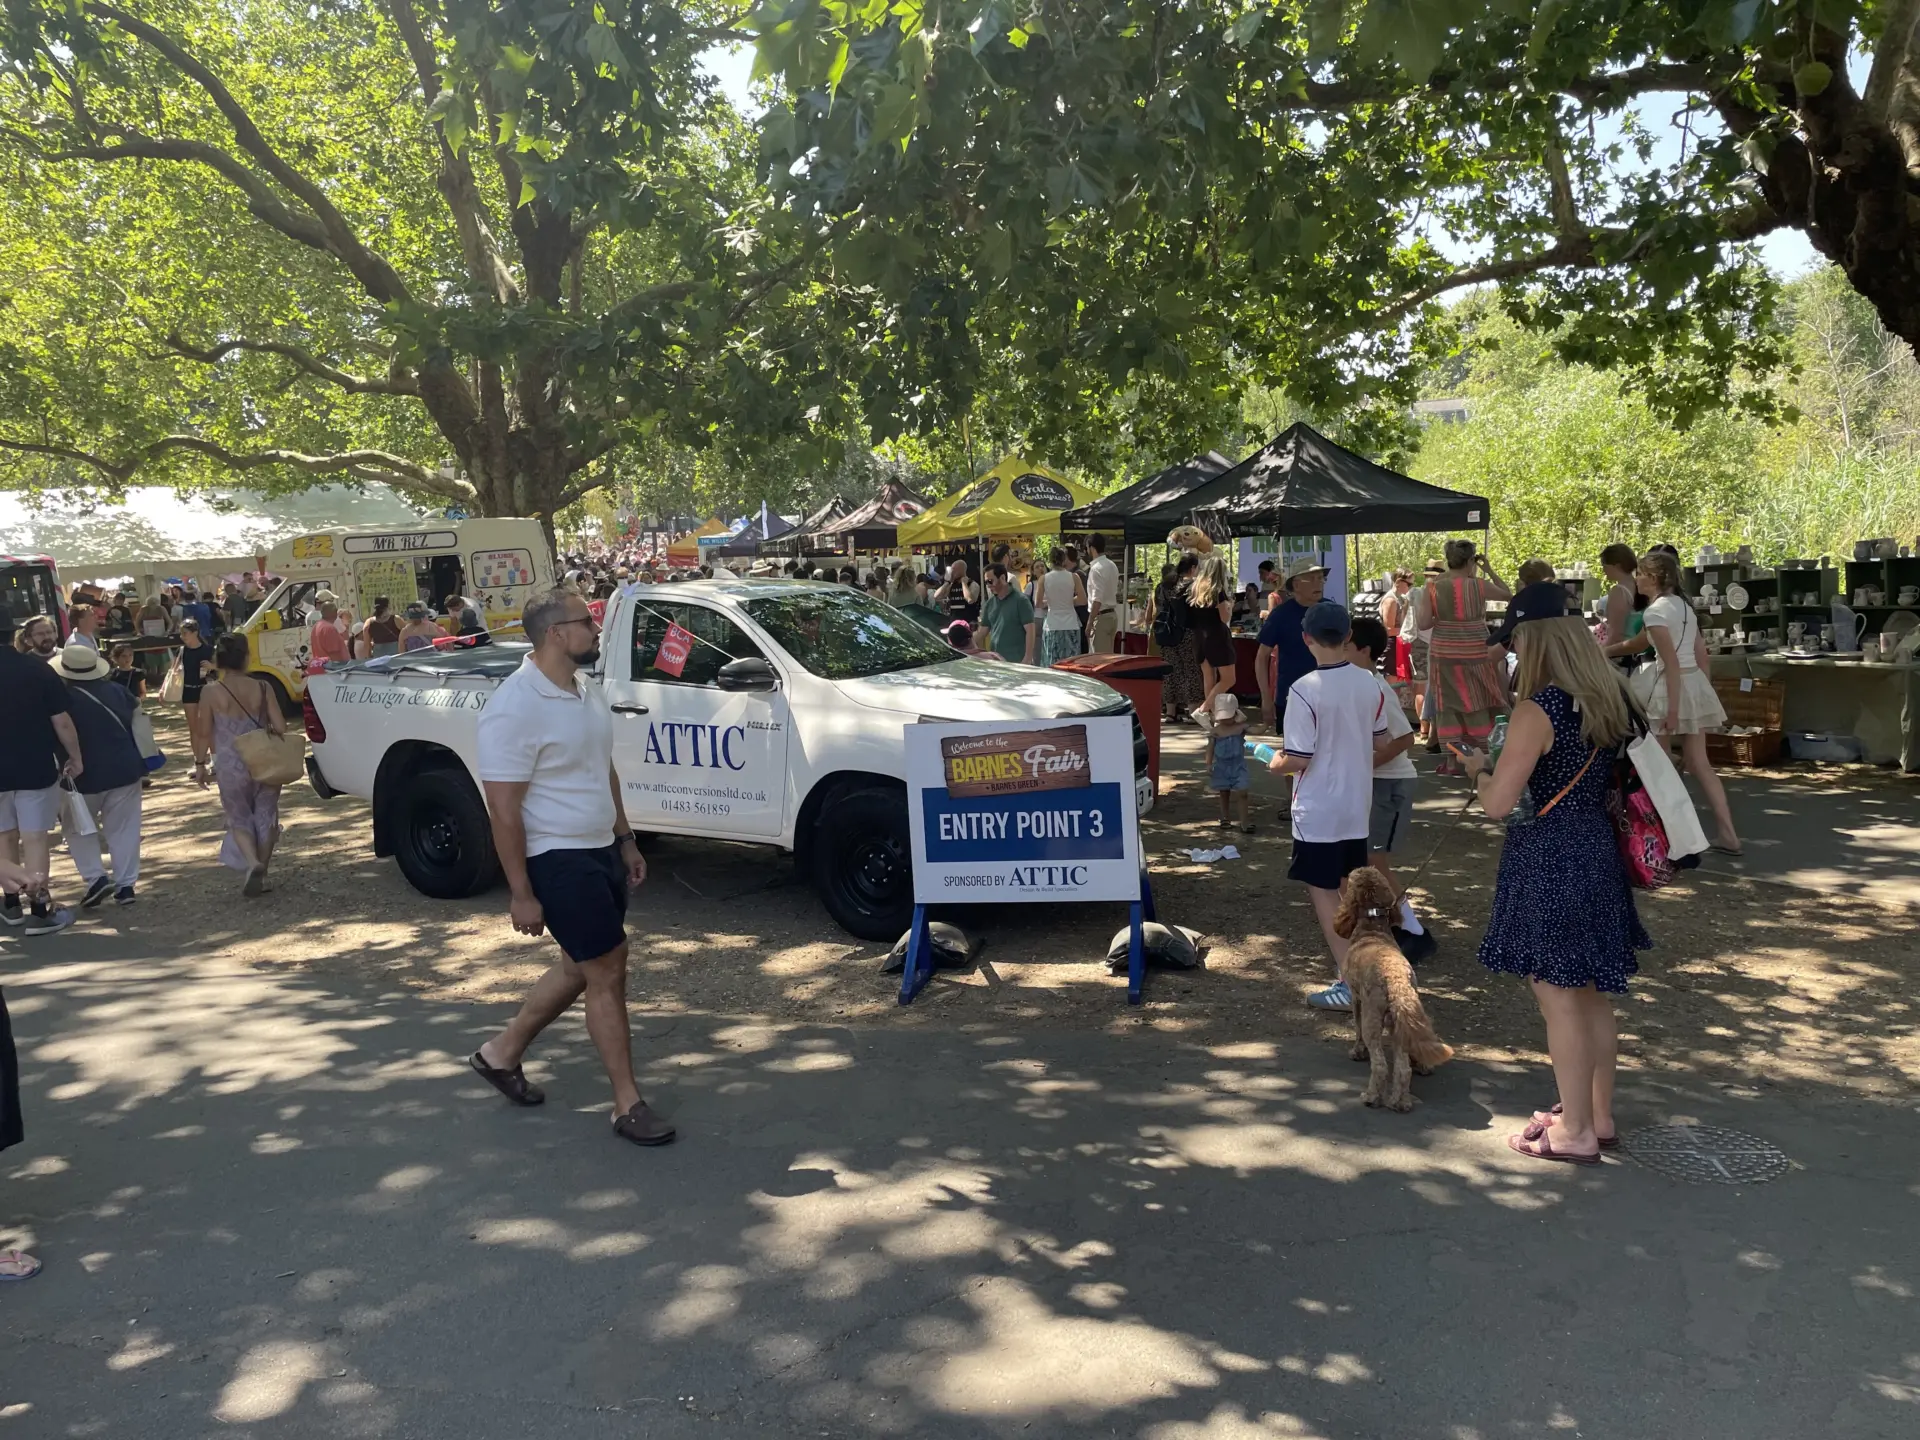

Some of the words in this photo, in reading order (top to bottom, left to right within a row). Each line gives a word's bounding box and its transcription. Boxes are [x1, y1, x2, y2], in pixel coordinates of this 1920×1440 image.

[1020, 482, 1057, 495] Fala
[372, 536, 395, 551] MR
[401, 534, 429, 549] REZ
[670, 626, 690, 644] BCA
[334, 685, 357, 704] The
[359, 686, 406, 709] Design
[407, 688, 423, 706] &
[424, 689, 469, 708] Build
[643, 721, 746, 771] ATTIC
[951, 739, 984, 755] Welcome
[986, 738, 994, 747] to
[995, 737, 1008, 748] the
[951, 752, 1023, 783] BARNES
[1023, 744, 1085, 778] Fair
[627, 781, 767, 802] www.atticconversionsltd.co.uk
[991, 781, 1017, 792] BARNES
[1017, 780, 1039, 790] GREEN
[661, 799, 691, 813] 01483
[693, 802, 731, 816] 561859
[939, 811, 1010, 841] ENTRY
[1016, 810, 1083, 839] POINT
[1089, 809, 1104, 838] 3
[944, 875, 993, 887] SPONSORED
[994, 875, 1006, 886] BY
[1008, 865, 1088, 886] ATTIC
